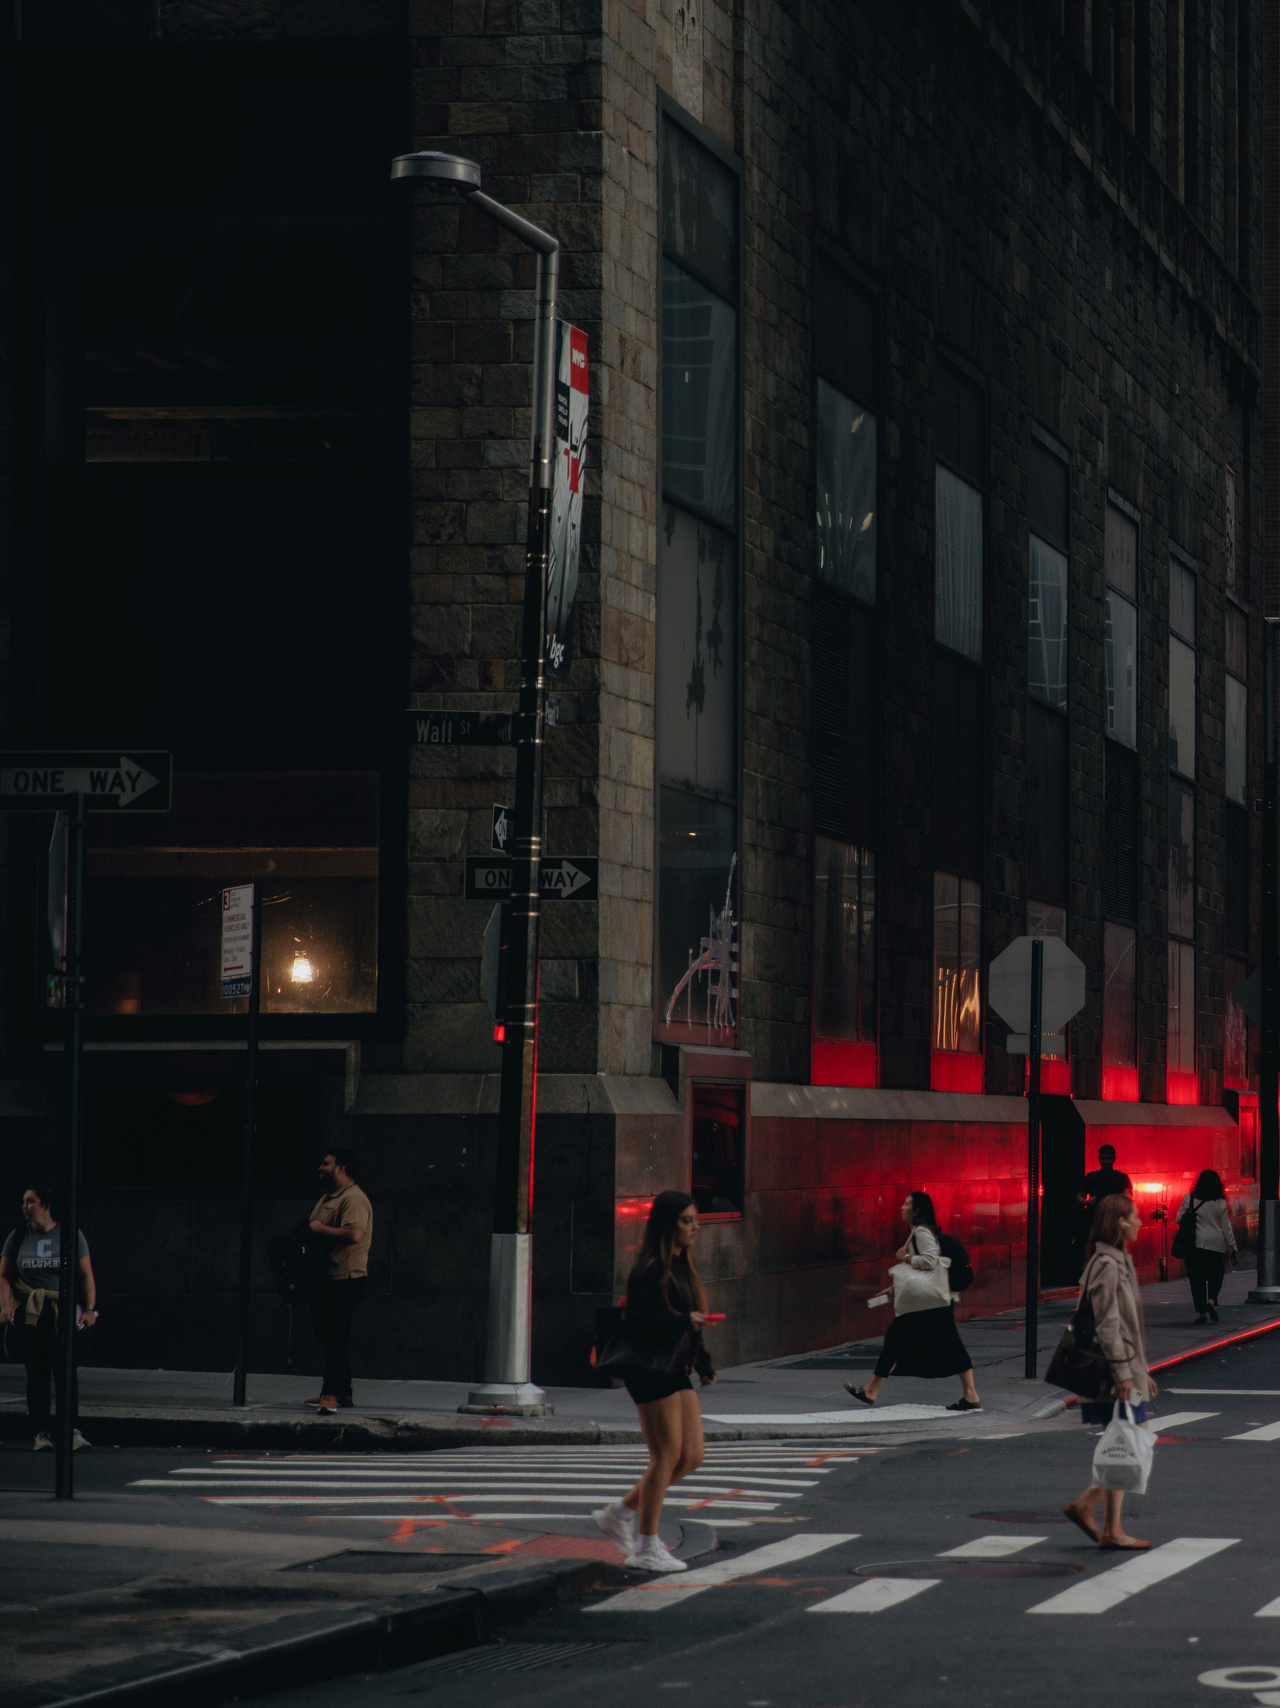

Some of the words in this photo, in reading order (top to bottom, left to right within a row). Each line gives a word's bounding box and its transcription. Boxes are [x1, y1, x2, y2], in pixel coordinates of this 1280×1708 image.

[416, 719, 452, 743] Wall
[460, 720, 471, 735] St
[13, 770, 65, 793] ONE
[89, 770, 143, 793] WAY
[485, 870, 510, 887] ON
[541, 871, 578, 887] WAY
[36, 1239, 52, 1257] C
[22, 1259, 60, 1269] COLUMB
[1102, 1446, 1135, 1457] MAGNOLIA
